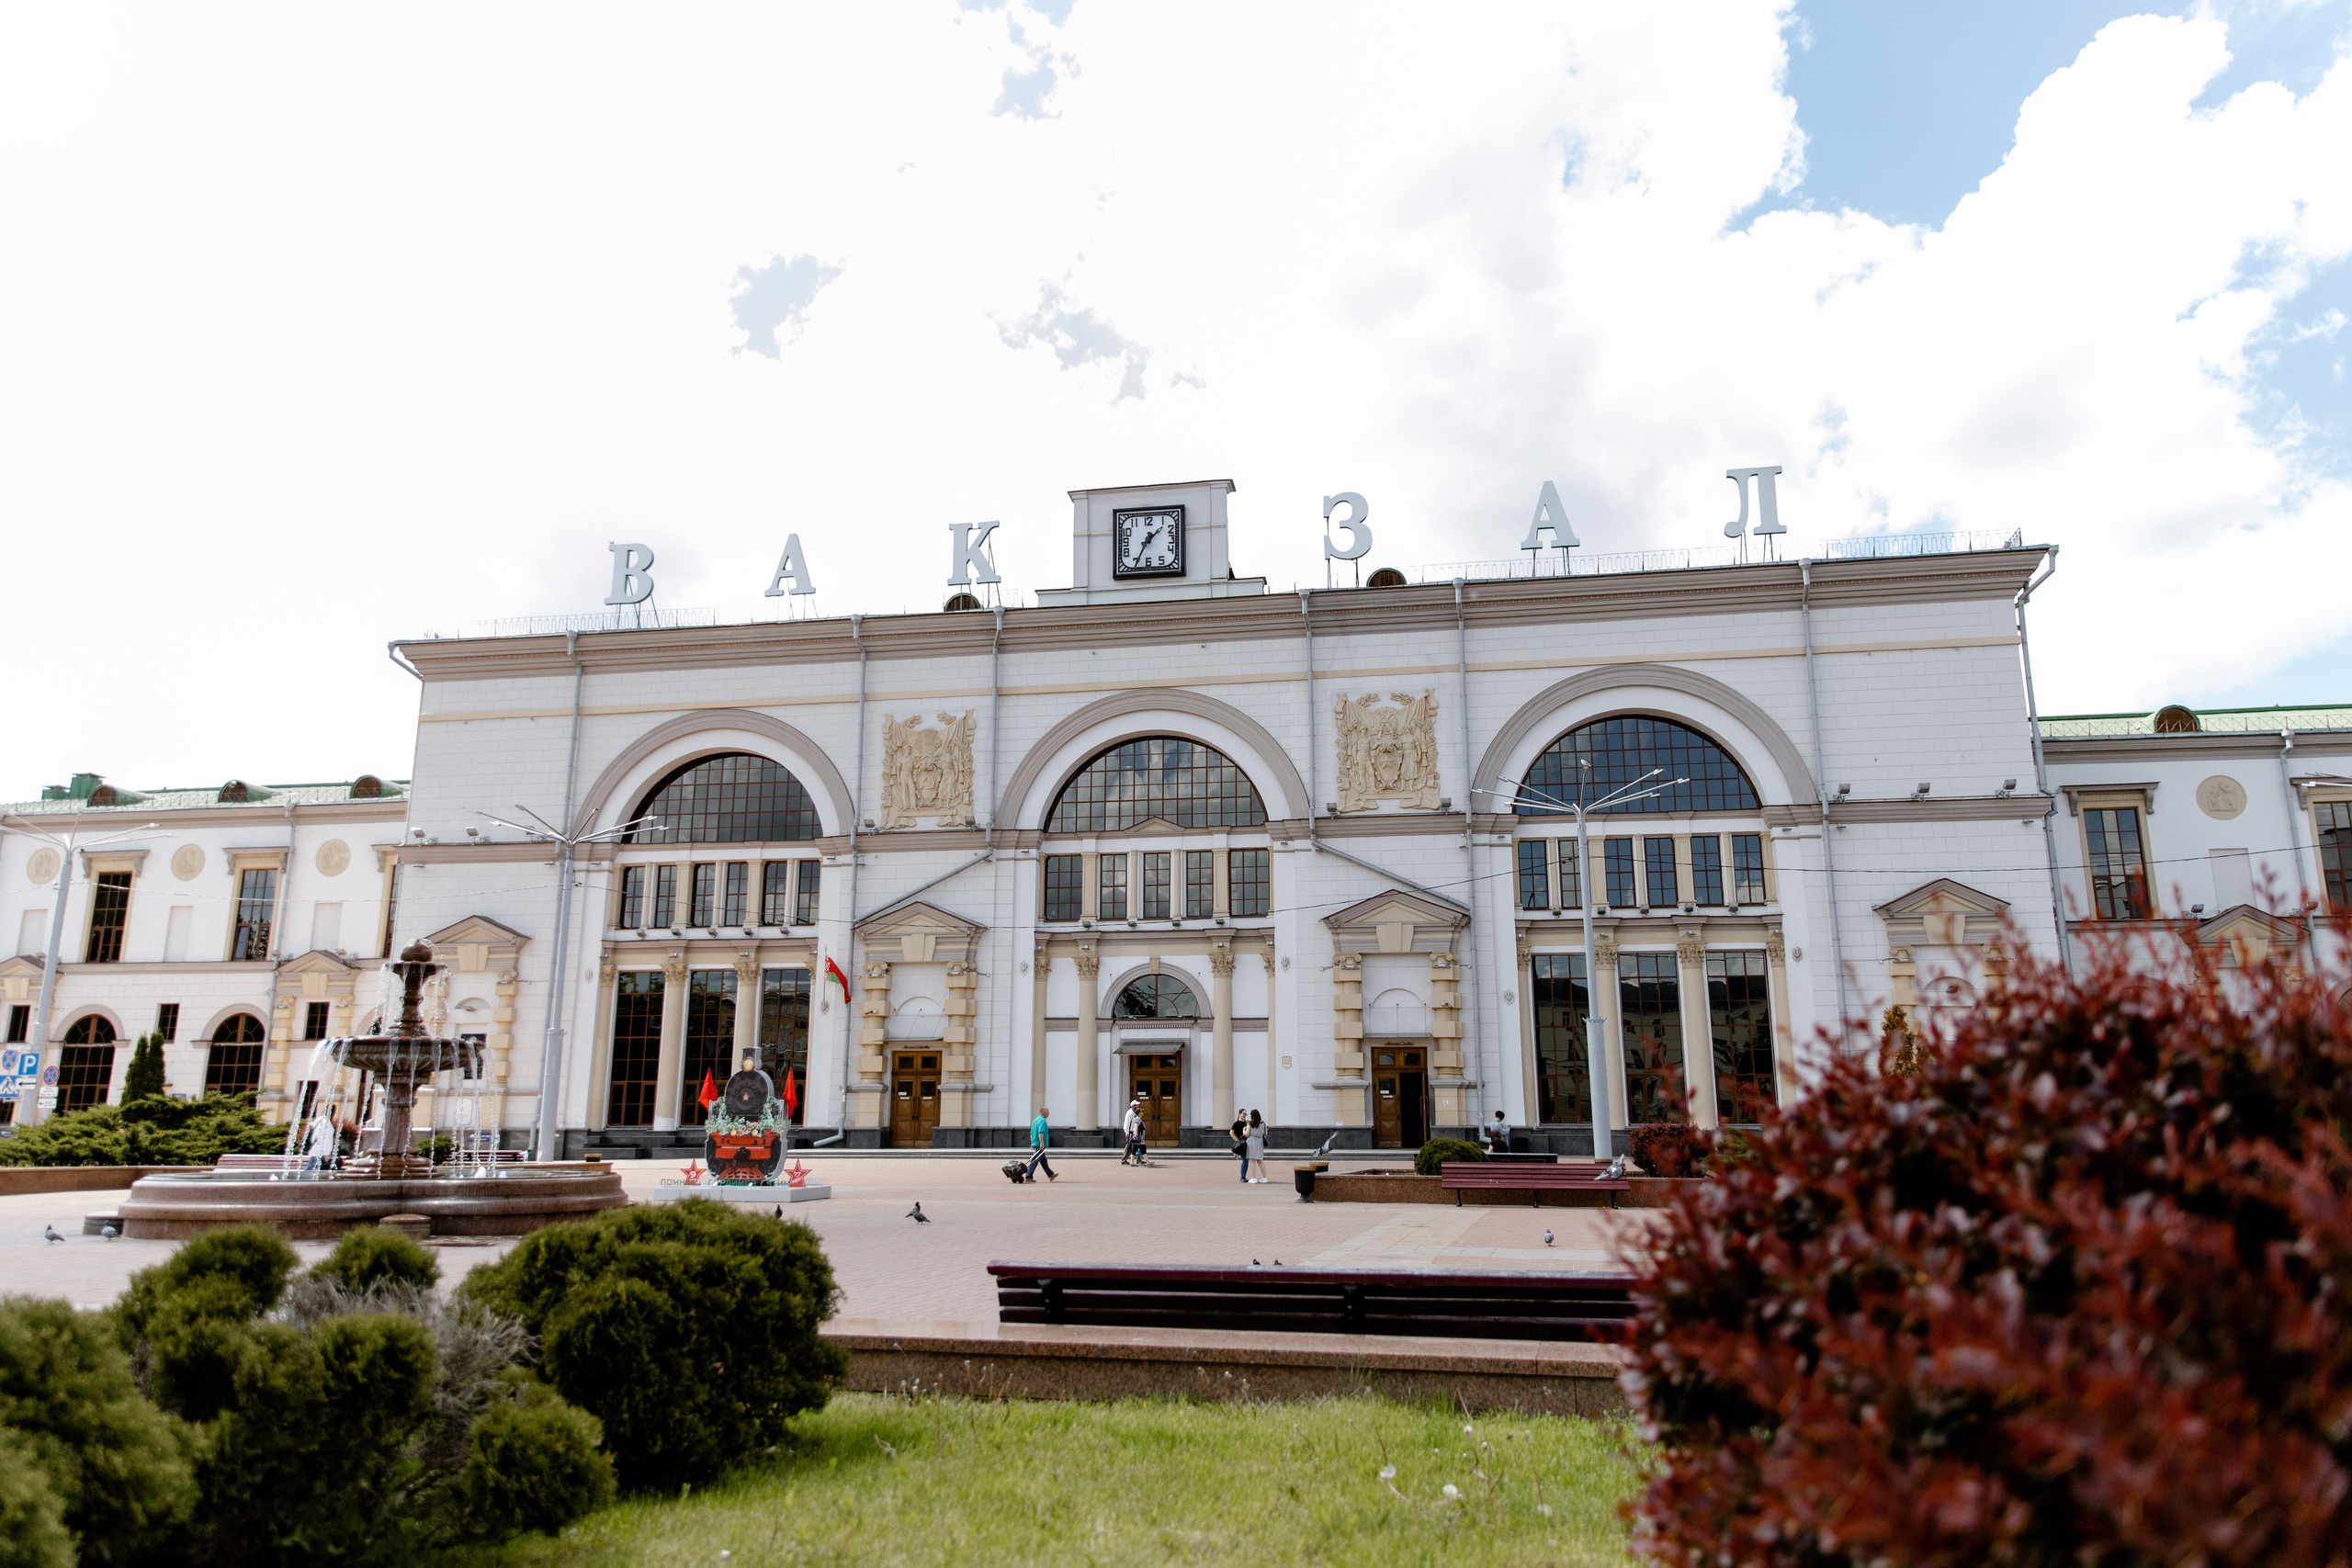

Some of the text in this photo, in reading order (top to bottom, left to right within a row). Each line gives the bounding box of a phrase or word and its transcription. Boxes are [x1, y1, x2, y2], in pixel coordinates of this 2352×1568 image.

[1131, 518, 1138, 528] 11
[1145, 516, 1153, 526] 12
[1123, 527, 1132, 537] 10
[1168, 525, 1174, 535] 2
[604, 466, 1787, 607] ВАКЗАЛ
[1168, 535, 1175, 545] 3
[1123, 537, 1129, 547] 9
[1124, 547, 1130, 558] 8
[1168, 545, 1174, 555] 4
[1145, 558, 1152, 567] 6
[1159, 556, 1165, 566] 5
[689, 1170, 696, 1179] 9
